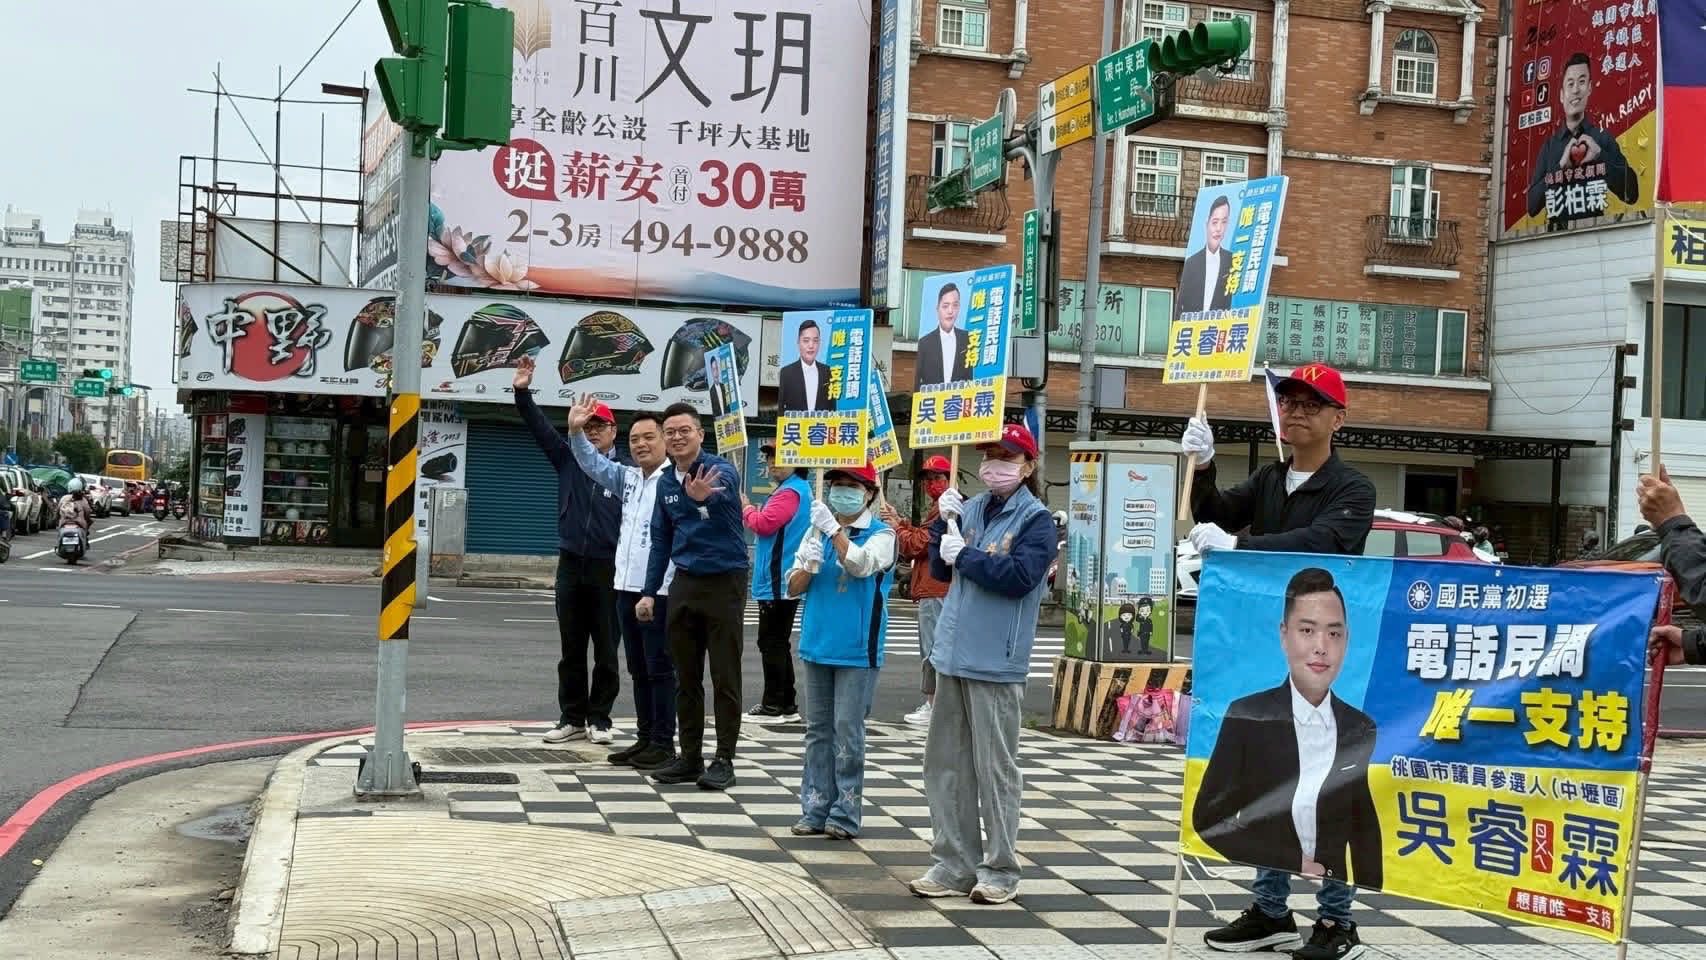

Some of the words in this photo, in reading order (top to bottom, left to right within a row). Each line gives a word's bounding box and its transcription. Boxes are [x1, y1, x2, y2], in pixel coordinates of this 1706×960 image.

[574, 0, 622, 101] 百川
[635, 0, 812, 116] 文玥
[1103, 48, 1145, 83] 環中東路
[1113, 76, 1143, 103] 二段
[1619, 83, 1653, 120] READY
[668, 119, 812, 153] 千坪大基地
[670, 165, 693, 204] 首付
[697, 158, 808, 213] 30萬
[1544, 179, 1609, 219] 彭柏霖
[506, 208, 602, 250] 2-3房
[621, 217, 810, 265] 494-9888
[1224, 203, 1257, 296] 唯一支持
[1241, 200, 1273, 294] 電話民調
[1024, 223, 1035, 317] 中山東路二段
[964, 287, 987, 369] 唯一支持
[982, 285, 1004, 366] 電話民調
[1288, 303, 1304, 361] 工商登記
[1311, 304, 1326, 362] 帳務處理
[827, 328, 847, 400] 唯一支持
[846, 327, 864, 399] 電話民調
[1436, 583, 1550, 610] 國民黨初選
[1406, 623, 1598, 681] 電話民調
[1419, 687, 1629, 751] 唯一支持
[1516, 890, 1612, 930] 懇請唯一支持
